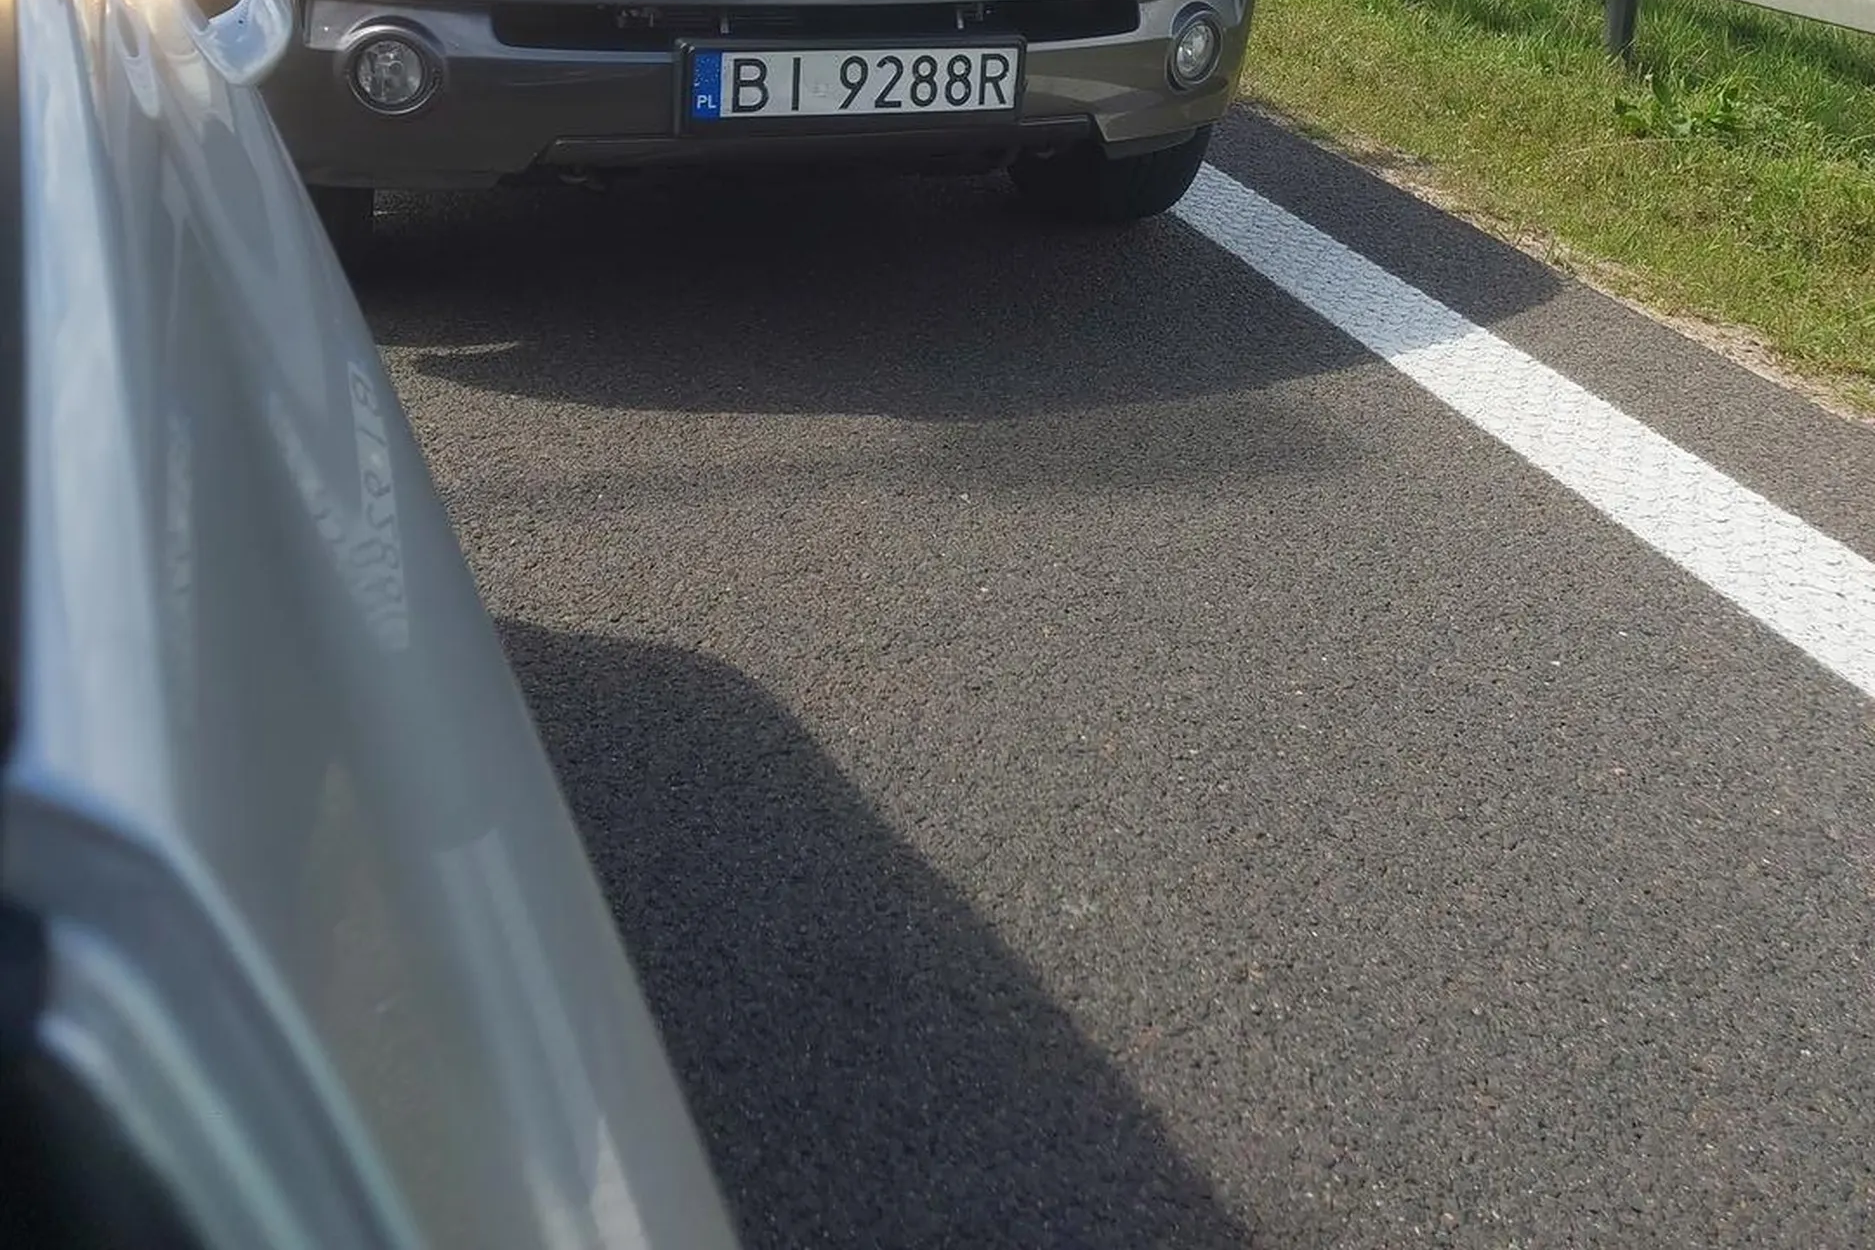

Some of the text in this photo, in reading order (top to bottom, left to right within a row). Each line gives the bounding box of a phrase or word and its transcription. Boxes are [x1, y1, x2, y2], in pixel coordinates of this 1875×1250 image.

[732, 54, 1010, 113] BI 9288R
[697, 95, 717, 109] PL
